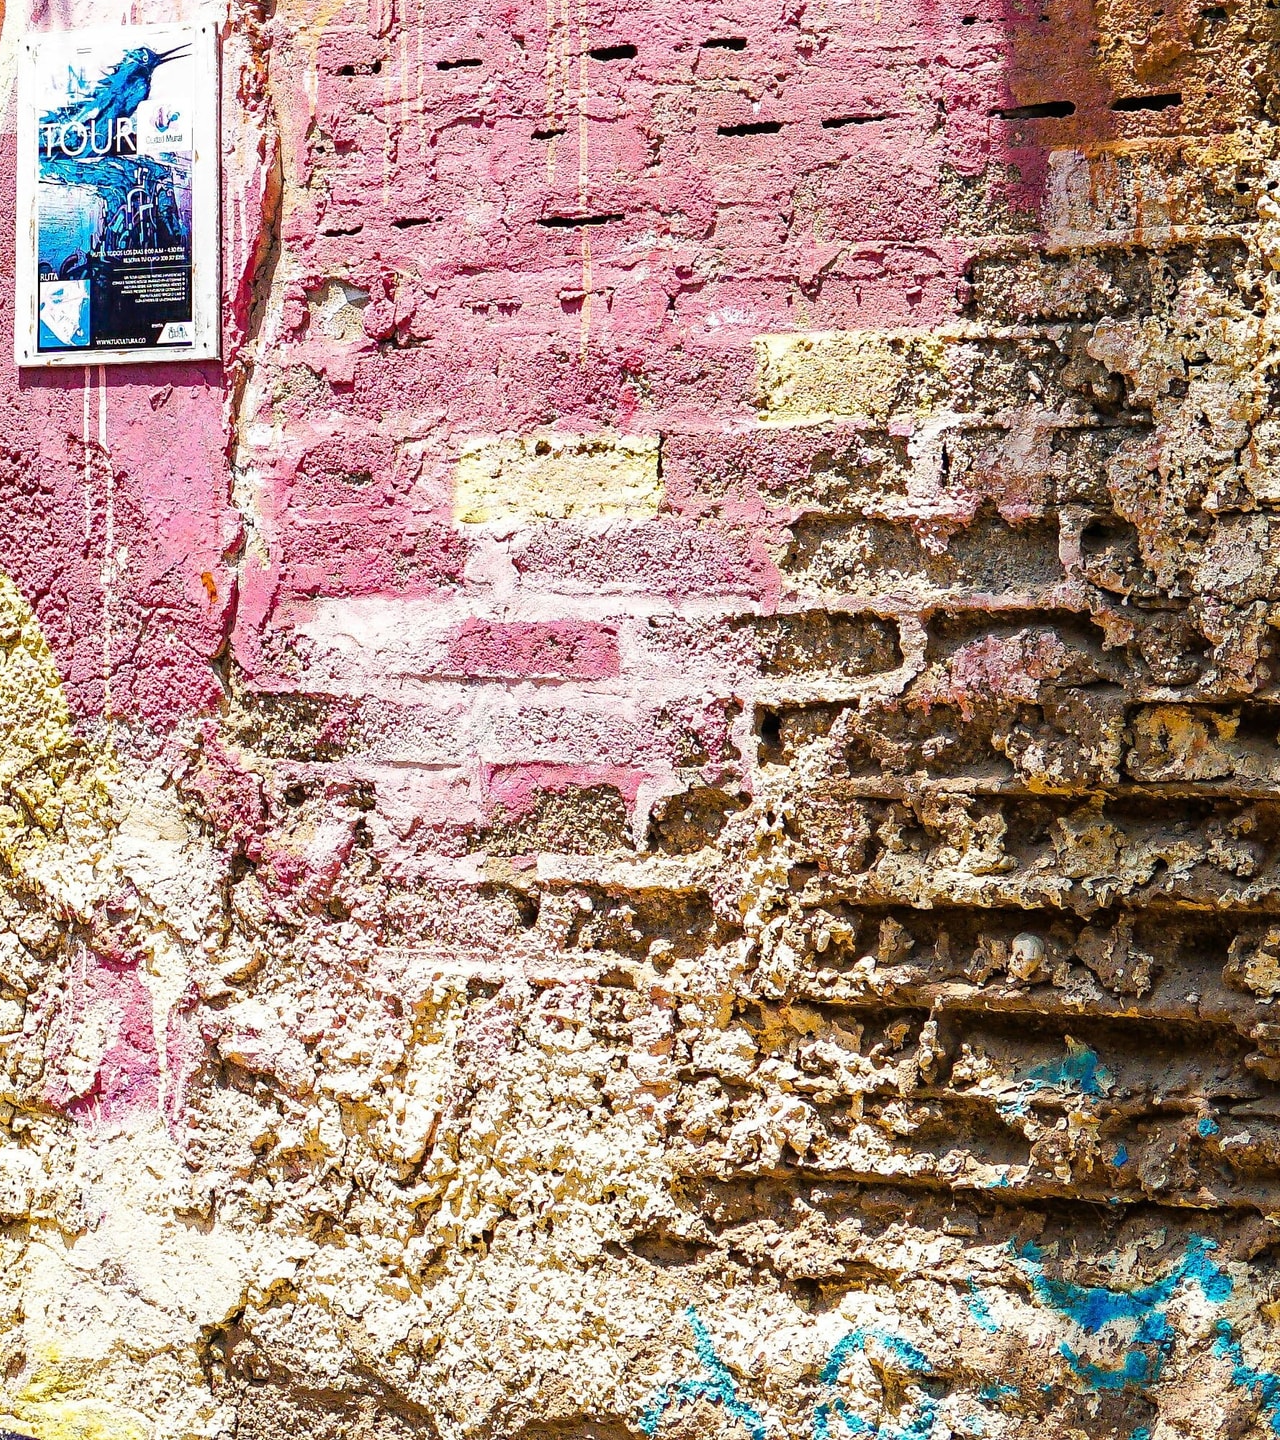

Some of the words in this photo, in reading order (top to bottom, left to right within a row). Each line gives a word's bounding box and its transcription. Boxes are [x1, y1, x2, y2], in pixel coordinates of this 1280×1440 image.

[40, 117, 137, 158] TOUR
[166, 134, 183, 143] Mural
[40, 272, 59, 281] RUTA
